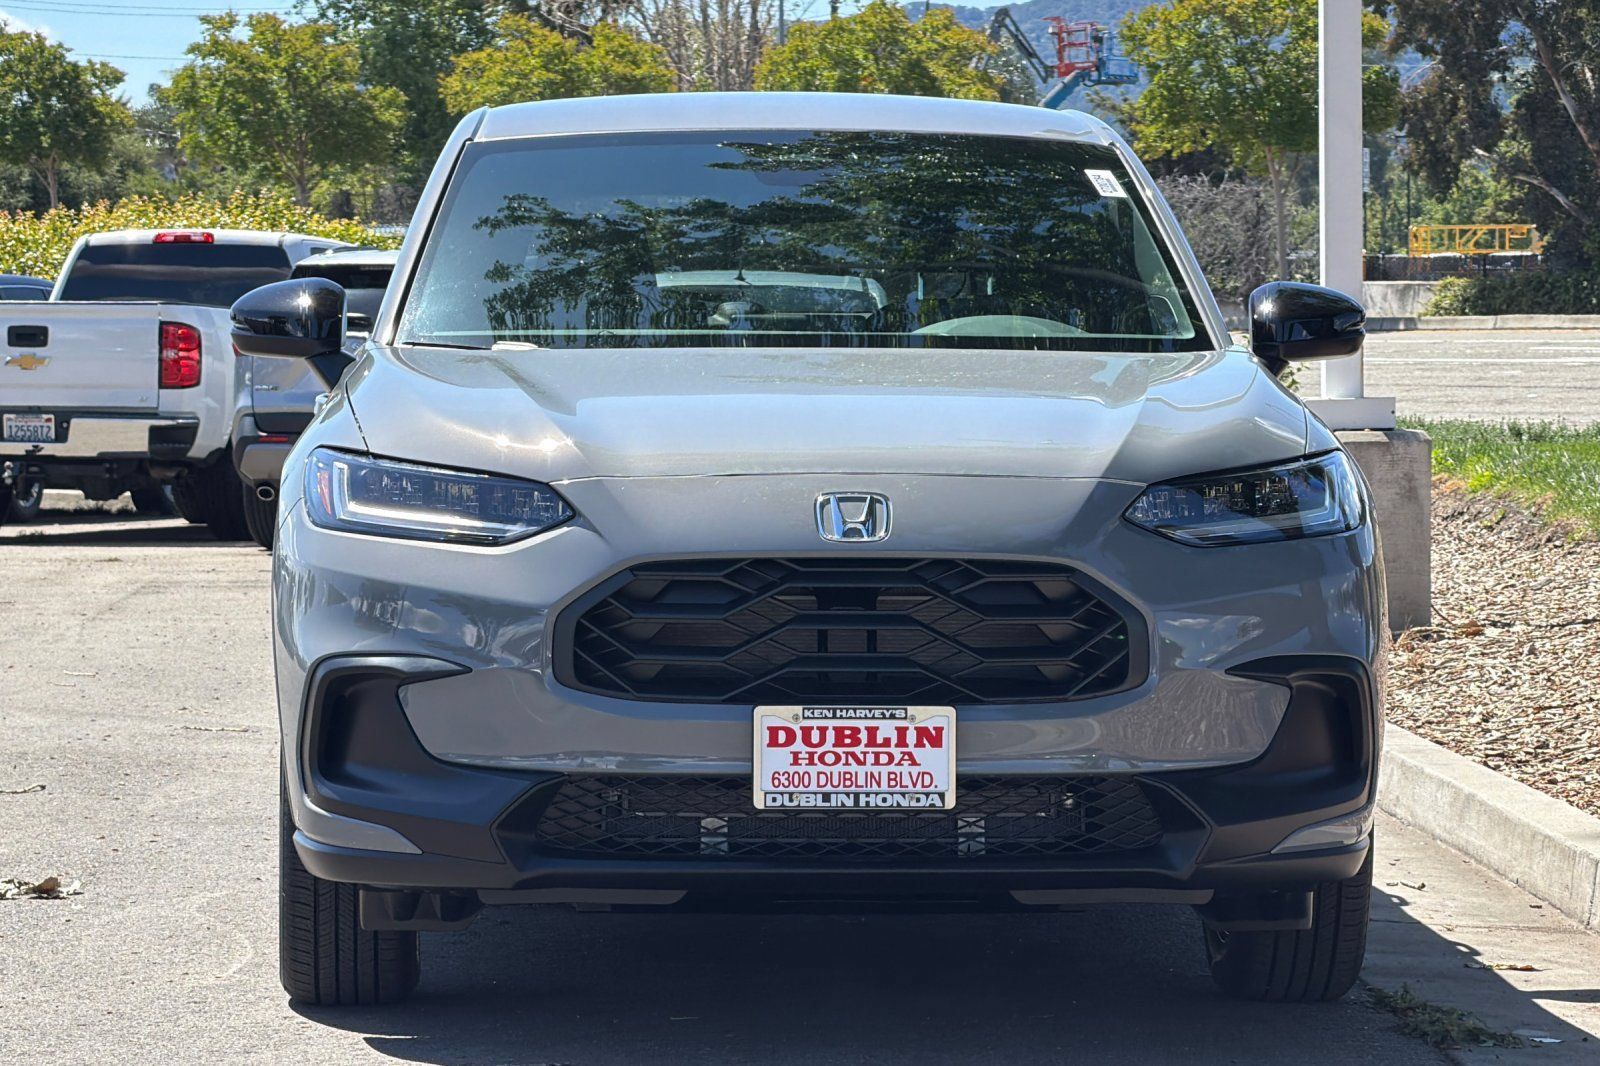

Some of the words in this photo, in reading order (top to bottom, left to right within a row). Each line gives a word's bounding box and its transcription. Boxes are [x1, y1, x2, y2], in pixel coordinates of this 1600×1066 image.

[803, 709, 833, 718] KEN
[836, 709, 906, 718] HARVEY'S
[766, 725, 945, 749] DUBLIN
[789, 750, 922, 767] HONDA
[771, 771, 812, 789] 6300
[816, 771, 882, 789] DUBLIN
[887, 771, 938, 789] BLVD.
[765, 793, 855, 807] DUBLIN
[859, 793, 943, 807] HONDA
